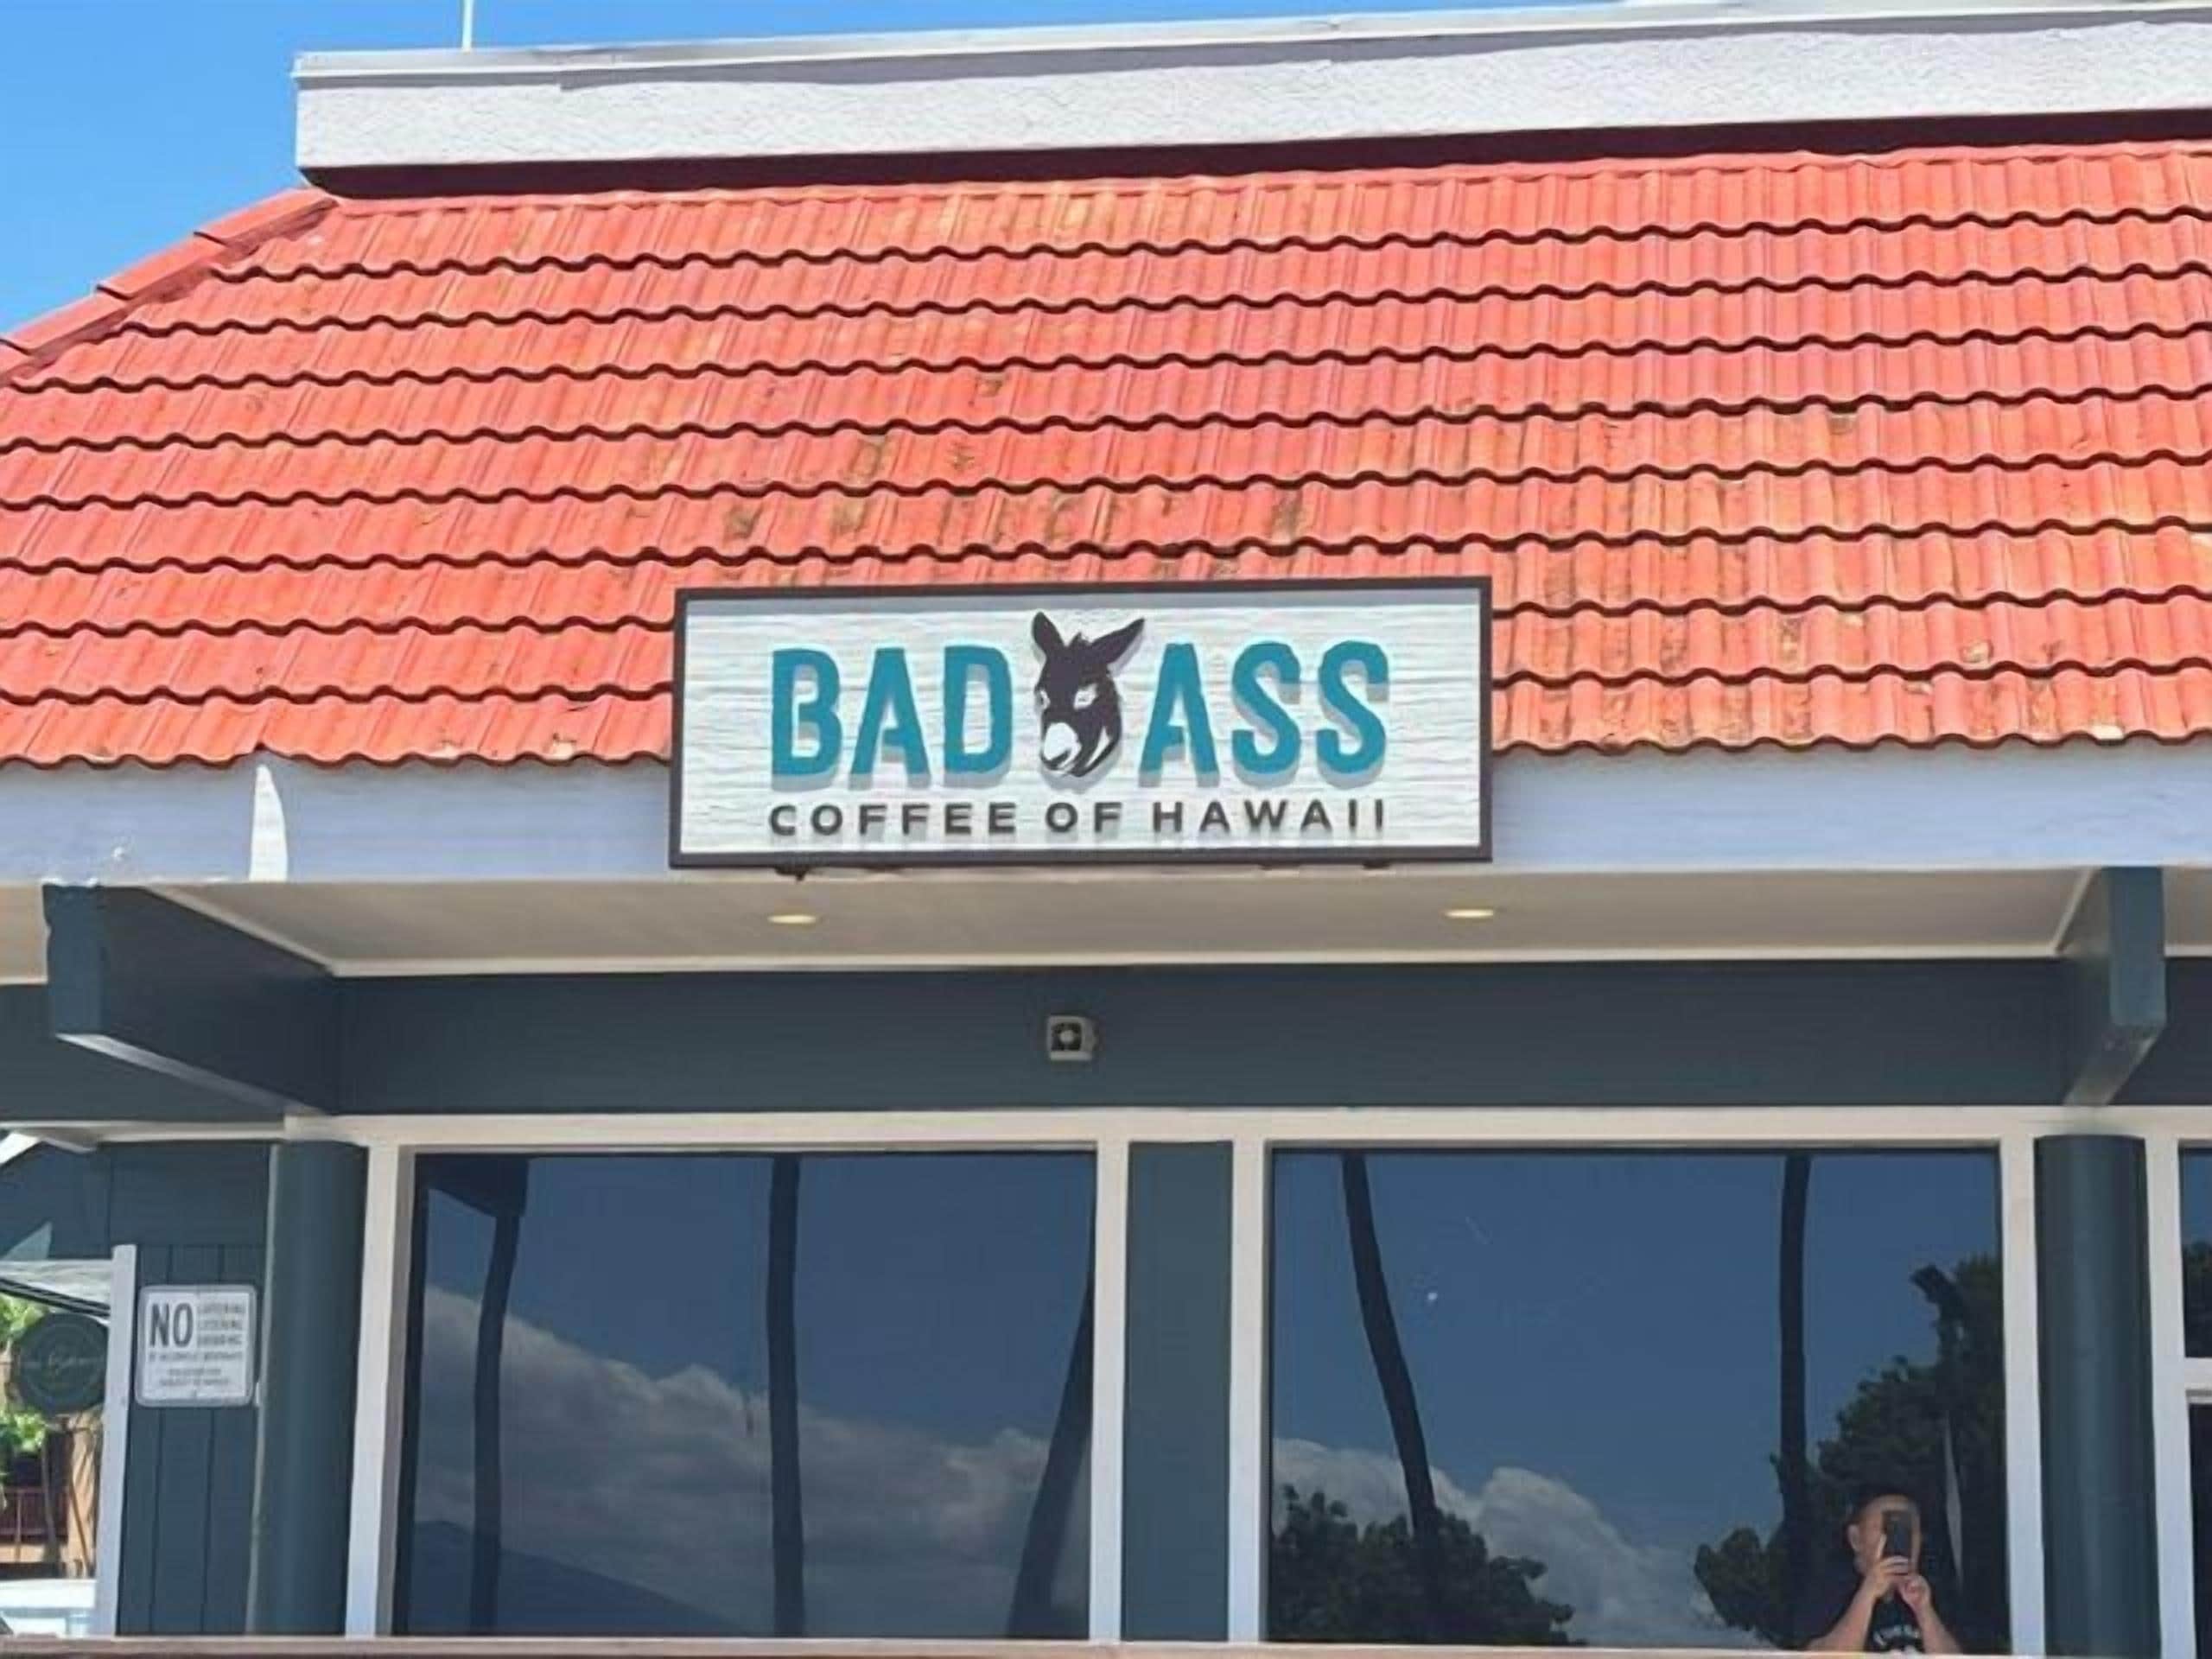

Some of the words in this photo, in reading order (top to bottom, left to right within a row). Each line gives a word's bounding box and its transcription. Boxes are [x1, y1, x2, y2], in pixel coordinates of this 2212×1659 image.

[772, 645, 1013, 775] BAD
[1138, 640, 1389, 775] ASS
[768, 802, 1017, 836] COFFEE
[1045, 802, 1122, 833] OF
[1152, 798, 1383, 833] HAWAII
[150, 1302, 194, 1348] NO
